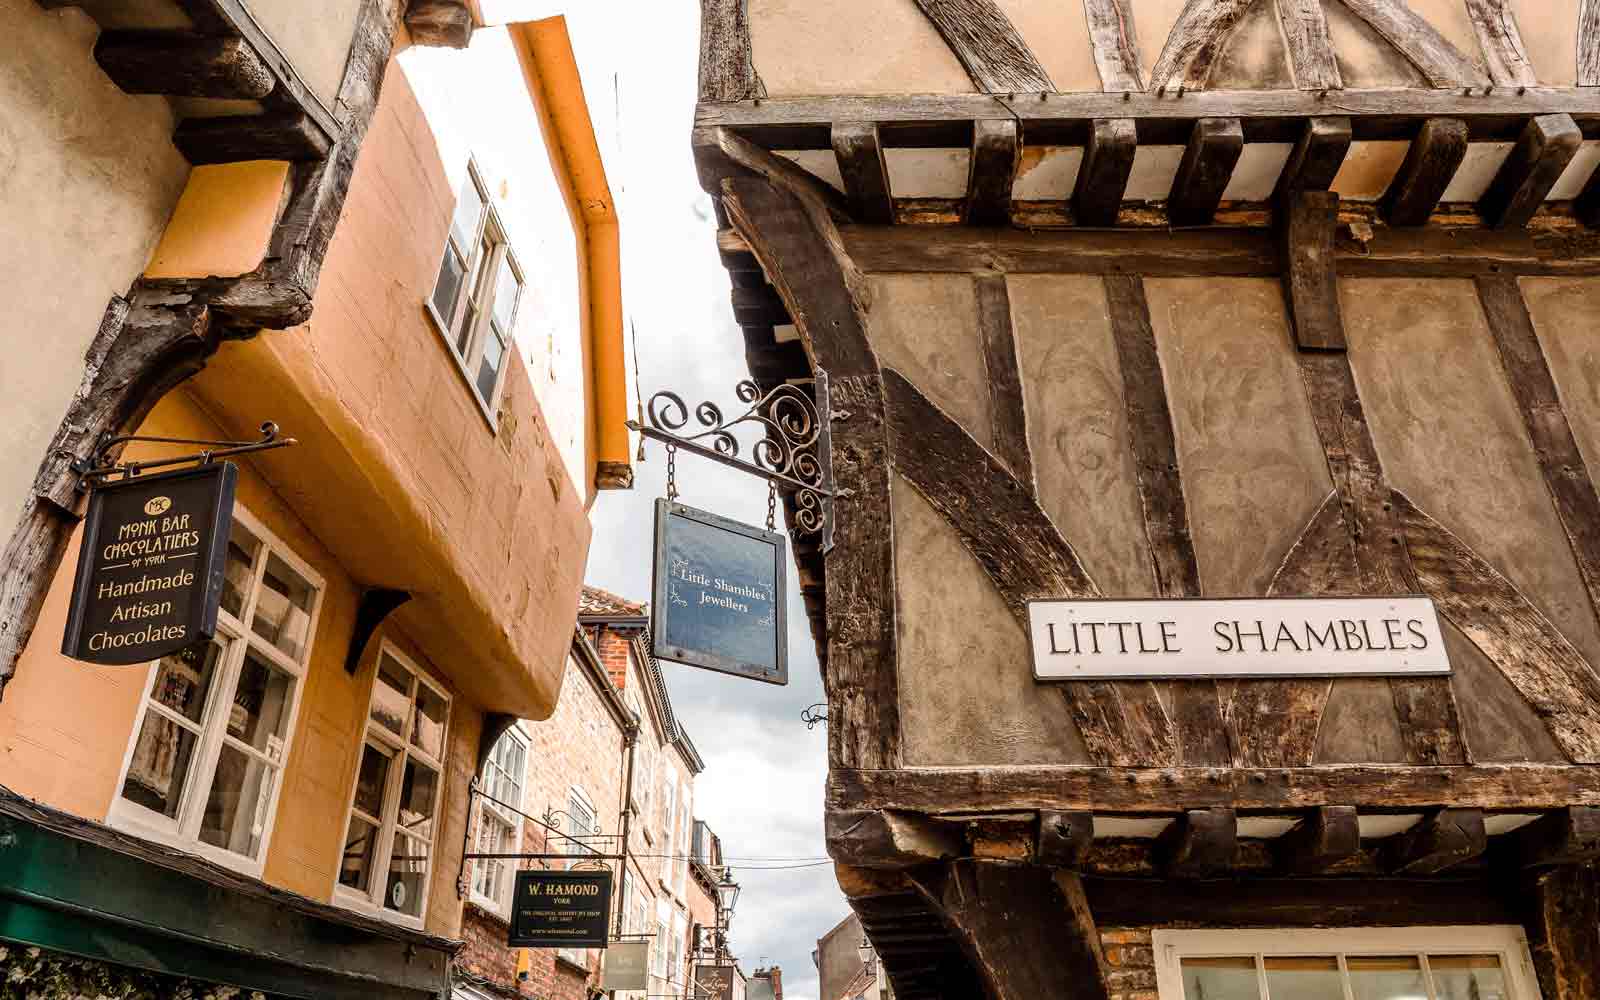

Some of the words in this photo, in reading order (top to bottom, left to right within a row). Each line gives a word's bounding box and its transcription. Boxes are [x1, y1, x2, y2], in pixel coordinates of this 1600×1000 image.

[118, 520, 157, 541] MONK
[162, 514, 190, 532] BAR
[104, 531, 200, 560] CHOCOLATIERS
[144, 555, 166, 567] YORK
[98, 569, 194, 600] Handmade
[681, 569, 711, 586] Little
[714, 578, 766, 601] Shambles
[110, 601, 171, 623] Artisan
[699, 591, 748, 612] Jewellers
[88, 624, 186, 651] Chocolates
[1046, 620, 1182, 655] LITTLE
[1213, 618, 1429, 653] SHAMBLES
[528, 883, 542, 896] W.
[546, 884, 599, 896] HAMOND
